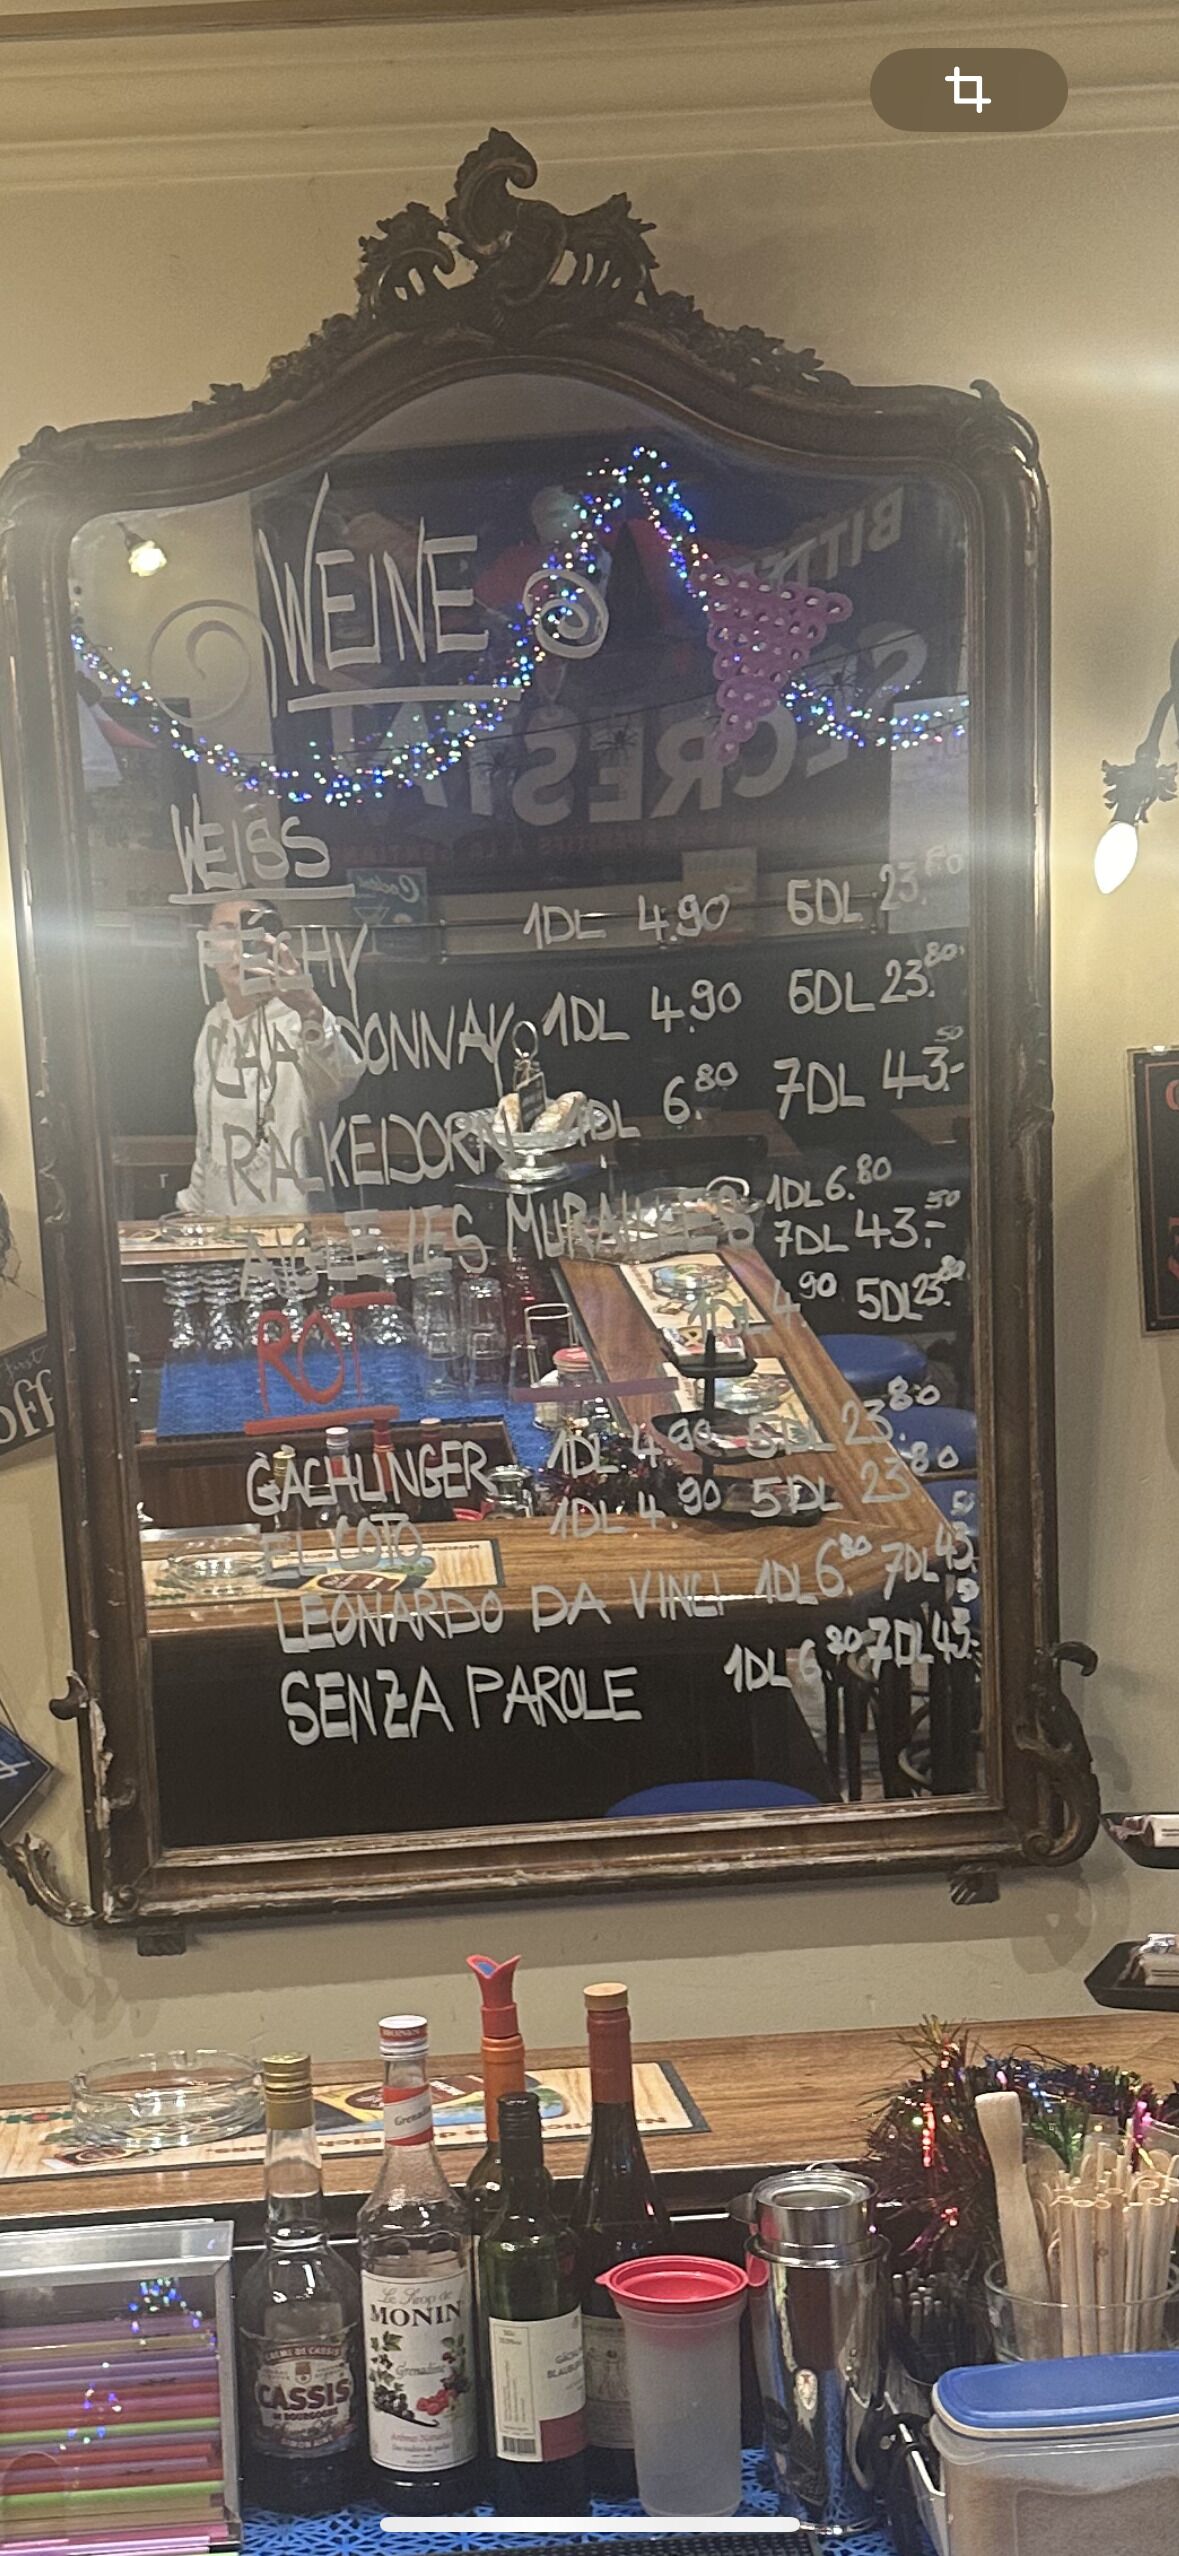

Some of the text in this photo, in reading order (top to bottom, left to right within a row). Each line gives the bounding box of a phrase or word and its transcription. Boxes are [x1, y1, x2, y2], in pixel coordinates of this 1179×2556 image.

[258, 473, 489, 686] WEINE
[523, 901, 607, 949] 1DL
[638, 894, 730, 943] 4.90
[543, 991, 630, 1046] 1DL
[651, 979, 742, 1033] 4.90
[773, 1056, 867, 1121] 7DL
[408, 1204, 489, 1280] LES
[766, 1174, 826, 1212] 1DL
[773, 1219, 851, 1259] 7DL
[856, 1276, 924, 1323] 5DL
[257, 1291, 398, 1416] ROT
[547, 1429, 620, 1478] 1DL
[746, 1415, 837, 1459] 5DL
[260, 1531, 328, 1582] EL
[335, 1512, 424, 1572] COTO
[550, 1496, 627, 1542] 1DL
[749, 1477, 843, 1519] 5DL
[273, 1588, 505, 1655] LEONARDO
[531, 1582, 613, 1633] DA
[629, 1571, 726, 1622] VINCI
[755, 1559, 820, 1607] 1DL
[880, 1542, 941, 1602] 7DL
[281, 1665, 455, 1746] SENZA
[466, 1664, 643, 1729] PAROLE
[723, 1643, 793, 1694] 1DL
[866, 1616, 935, 1682] 7DL
[370, 2299, 463, 2328] MONIN
[258, 2378, 350, 2411] CASSIS
